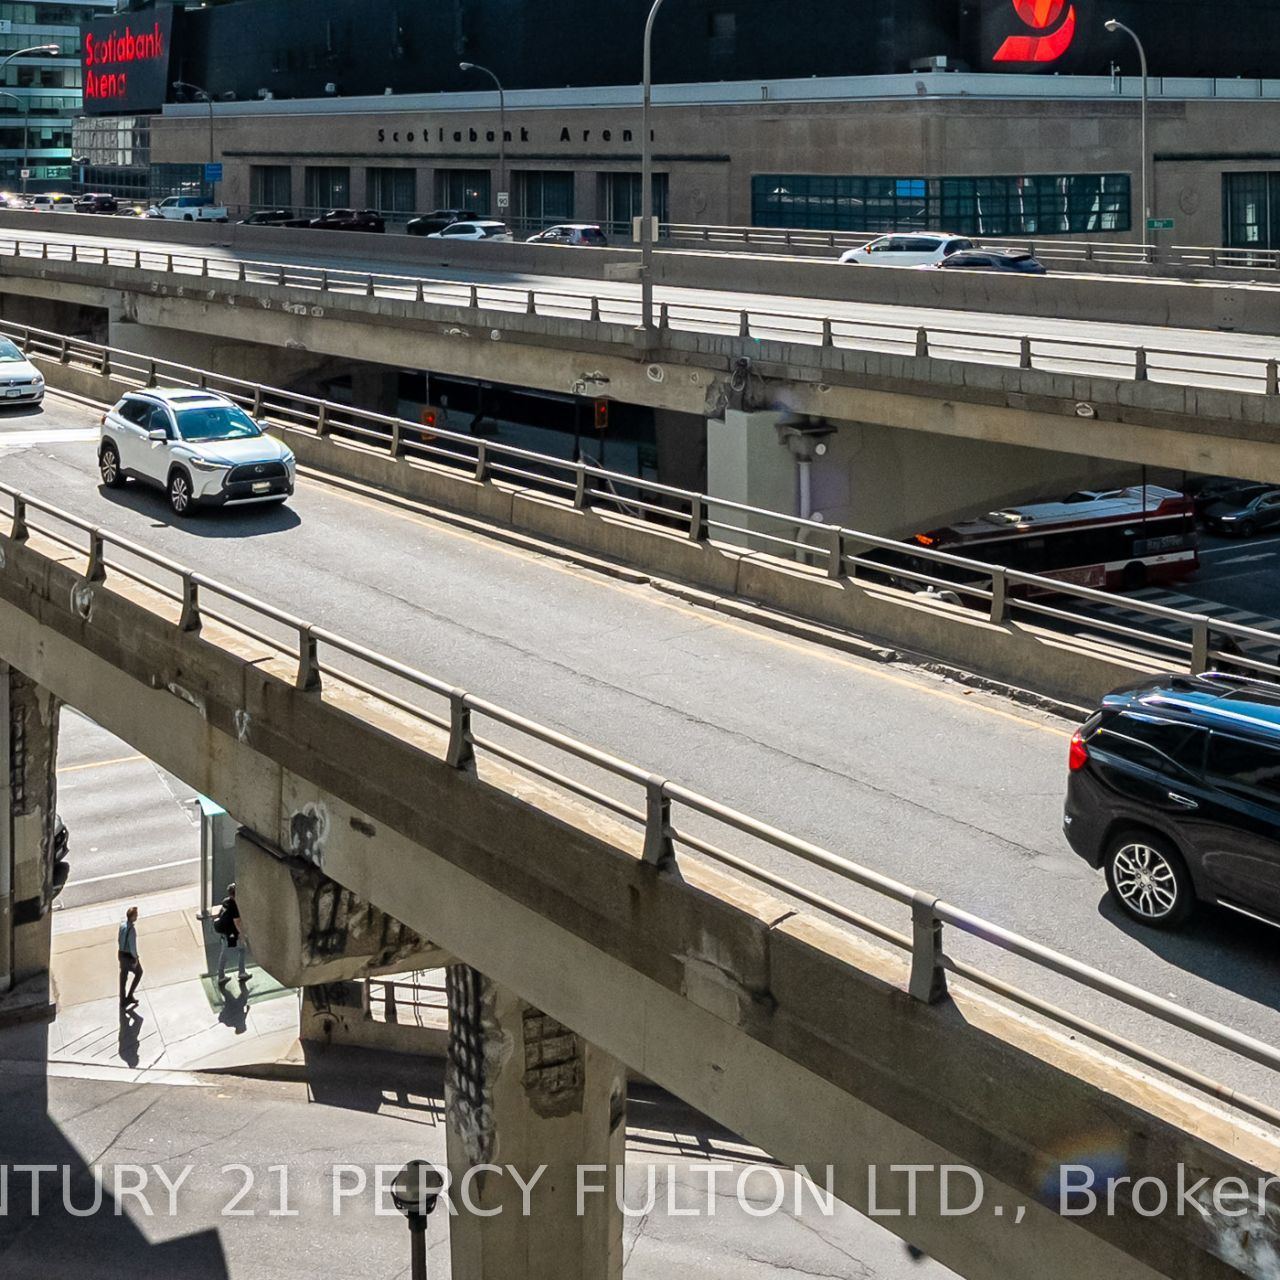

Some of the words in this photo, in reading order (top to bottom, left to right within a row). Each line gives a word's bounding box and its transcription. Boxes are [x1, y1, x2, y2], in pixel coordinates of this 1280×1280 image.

[86, 22, 164, 67] Scotiabank
[86, 70, 126, 98] Arena
[378, 127, 529, 143] Scotiabank
